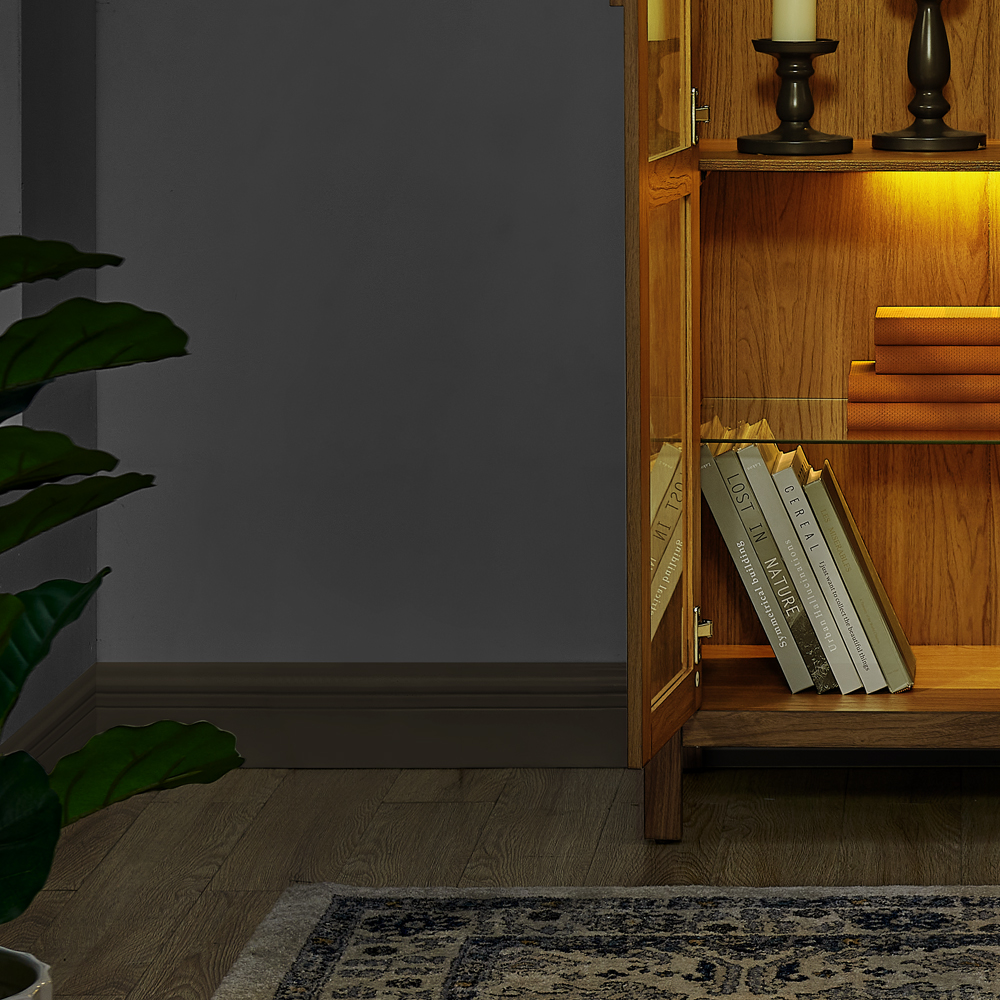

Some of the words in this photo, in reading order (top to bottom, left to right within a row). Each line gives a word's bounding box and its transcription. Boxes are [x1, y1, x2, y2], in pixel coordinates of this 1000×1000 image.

[727, 473, 755, 511] LOST
[749, 523, 767, 543] IN
[764, 557, 800, 617] NATURE
[785, 486, 819, 551] CEREAL
[820, 508, 830, 523] LES
[737, 541, 759, 585] building
[786, 540, 823, 618] Hallucinations
[754, 587, 787, 647] Symmetrical
[819, 565, 829, 576] just
[826, 576, 835, 591] want
[835, 598, 846, 617] collect
[843, 616, 852, 627] the
[848, 626, 863, 653] beautiful
[859, 653, 869, 671] things
[820, 620, 837, 652] Urban
